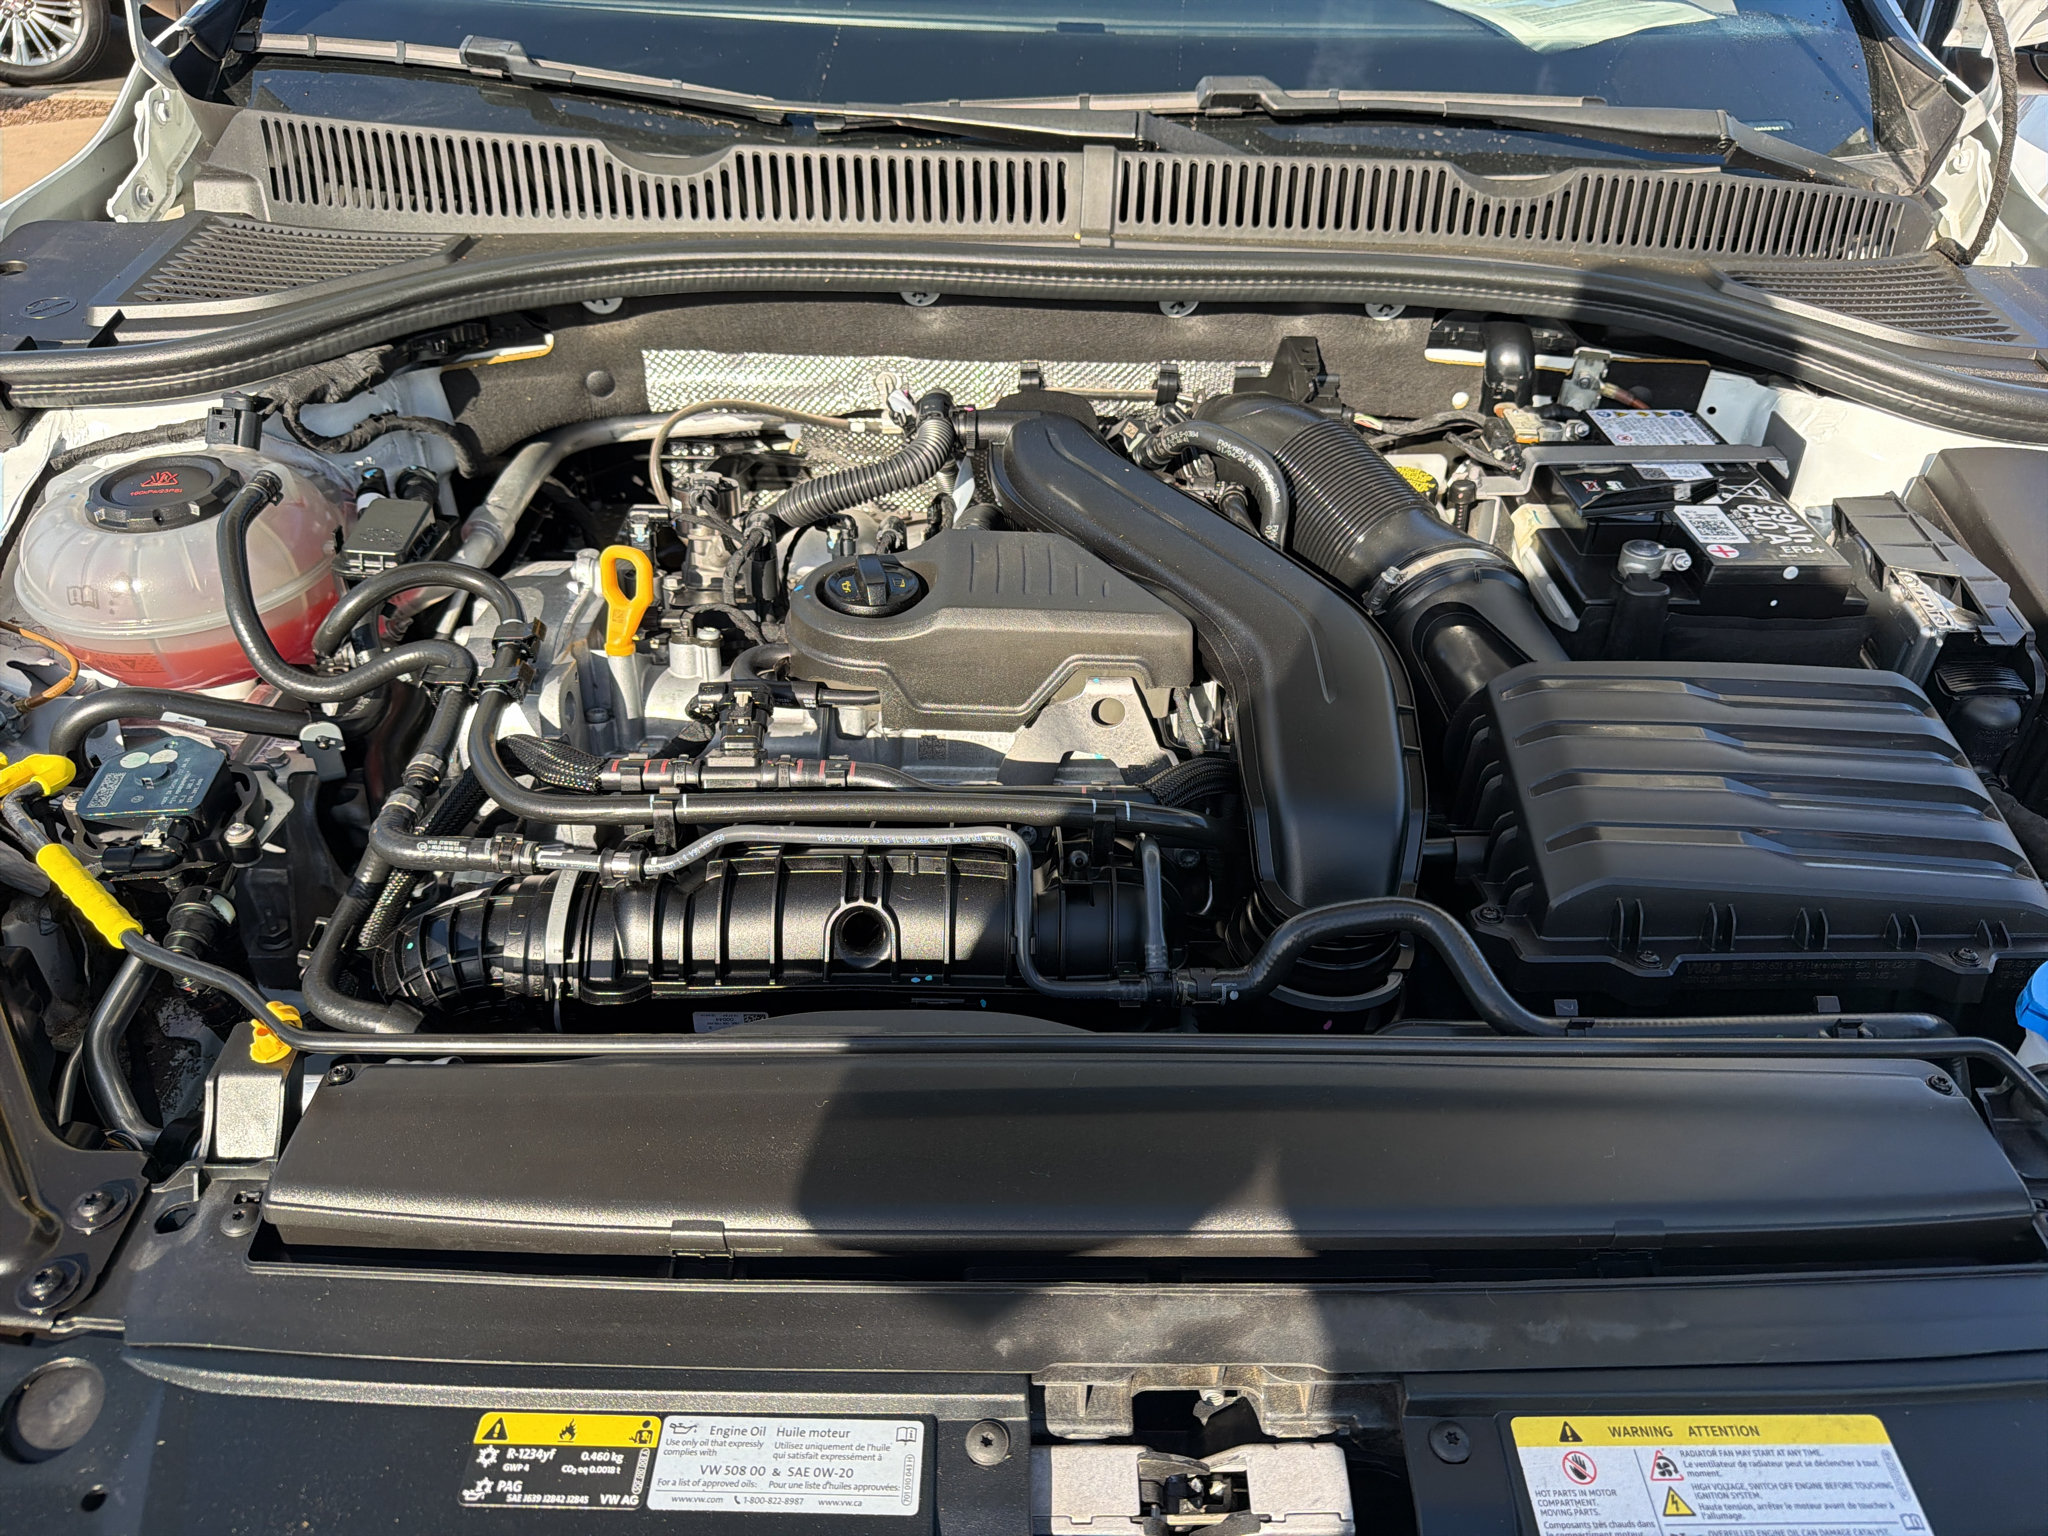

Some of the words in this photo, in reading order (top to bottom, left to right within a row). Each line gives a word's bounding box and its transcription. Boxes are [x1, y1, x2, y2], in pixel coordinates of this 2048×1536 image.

[1737, 504, 1779, 530] 640
[1763, 532, 1792, 545] A
[1779, 545, 1824, 554] EFB+
[710, 1425, 748, 1439] Engine
[750, 1426, 766, 1436] Oil
[776, 1427, 806, 1438] Huile
[809, 1429, 851, 1439] moteur
[1608, 1426, 1673, 1437] WARNING
[1688, 1425, 1760, 1437] ATTENTION
[665, 1438, 681, 1446] Use
[681, 1438, 698, 1448] only
[700, 1438, 709, 1446] oil
[711, 1439, 726, 1447] that
[728, 1440, 765, 1450] expressly
[774, 1442, 803, 1450] Utilisez
[805, 1443, 854, 1453] uniquement
[855, 1443, 865, 1451] de
[867, 1443, 891, 1452] l'huile
[506, 1448, 557, 1463] R-1234yf
[580, 1451, 610, 1461] 0.460
[611, 1452, 624, 1464] kg
[663, 1448, 698, 1458] complies
[699, 1448, 717, 1456] with
[773, 1452, 786, 1460] qui
[787, 1451, 819, 1460] satisfait
[820, 1453, 876, 1462] expressément
[877, 1453, 882, 1461] à
[1680, 1449, 1717, 1457] RADIATOR
[1719, 1449, 1734, 1457] FAN
[1735, 1449, 1751, 1457] MAY
[1753, 1449, 1775, 1457] START
[1776, 1449, 1786, 1457] AT
[1787, 1449, 1801, 1457] ANY
[1803, 1449, 1824, 1457] TIME.
[502, 1463, 523, 1472] GWP
[523, 1463, 530, 1472] 4
[1683, 1460, 1693, 1468] Le
[1695, 1460, 1736, 1468] ventilateur
[1738, 1460, 1748, 1468] de
[1749, 1460, 1783, 1468] radiateur
[1785, 1460, 1802, 1468] peut
[577, 1466, 588, 1476] eq
[616, 1466, 622, 1474] t
[700, 1465, 722, 1475] VW
[724, 1465, 747, 1476] 508
[749, 1466, 766, 1476] 00
[772, 1467, 781, 1477] &
[787, 1467, 811, 1477] SAE
[813, 1467, 854, 1478] 0W-20
[1687, 1470, 1722, 1478] moment.
[496, 1480, 523, 1493] PAG
[657, 1478, 669, 1487] For
[678, 1478, 690, 1487] list
[691, 1478, 701, 1487] of
[702, 1479, 740, 1489] approved
[741, 1480, 758, 1488] oils:
[768, 1480, 787, 1489] Pour
[805, 1481, 821, 1490] liste
[822, 1481, 851, 1490] d'huiles
[1691, 1483, 1711, 1491] HIGH
[1749, 1482, 1777, 1490] SWITCH
[1779, 1482, 1794, 1490] OFF
[1795, 1482, 1824, 1490] ENGINE
[1825, 1482, 1854, 1490] BEFORE
[505, 1493, 522, 1503] SAE
[1535, 1489, 1551, 1497] HOT
[1553, 1489, 1577, 1497] PARTS
[1579, 1489, 1588, 1497] IN
[1588, 1489, 1617, 1497] MOTOR
[1695, 1492, 1730, 1500] IGNITION
[600, 1493, 621, 1505] VW
[620, 1494, 640, 1506] AG
[671, 1496, 724, 1504] www.vw.com
[743, 1496, 804, 1506] 1-800-822-8987
[818, 1499, 863, 1507] www.vw.ca
[1537, 1499, 1599, 1507] COMPARTMENT.
[1698, 1502, 1723, 1511] Haute
[1540, 1508, 1573, 1516] MOVING
[1574, 1508, 1600, 1516] PARTS.
[1543, 1520, 1591, 1530] Composants
[1608, 1520, 1635, 1528] chauds
[1637, 1520, 1655, 1528] dans
